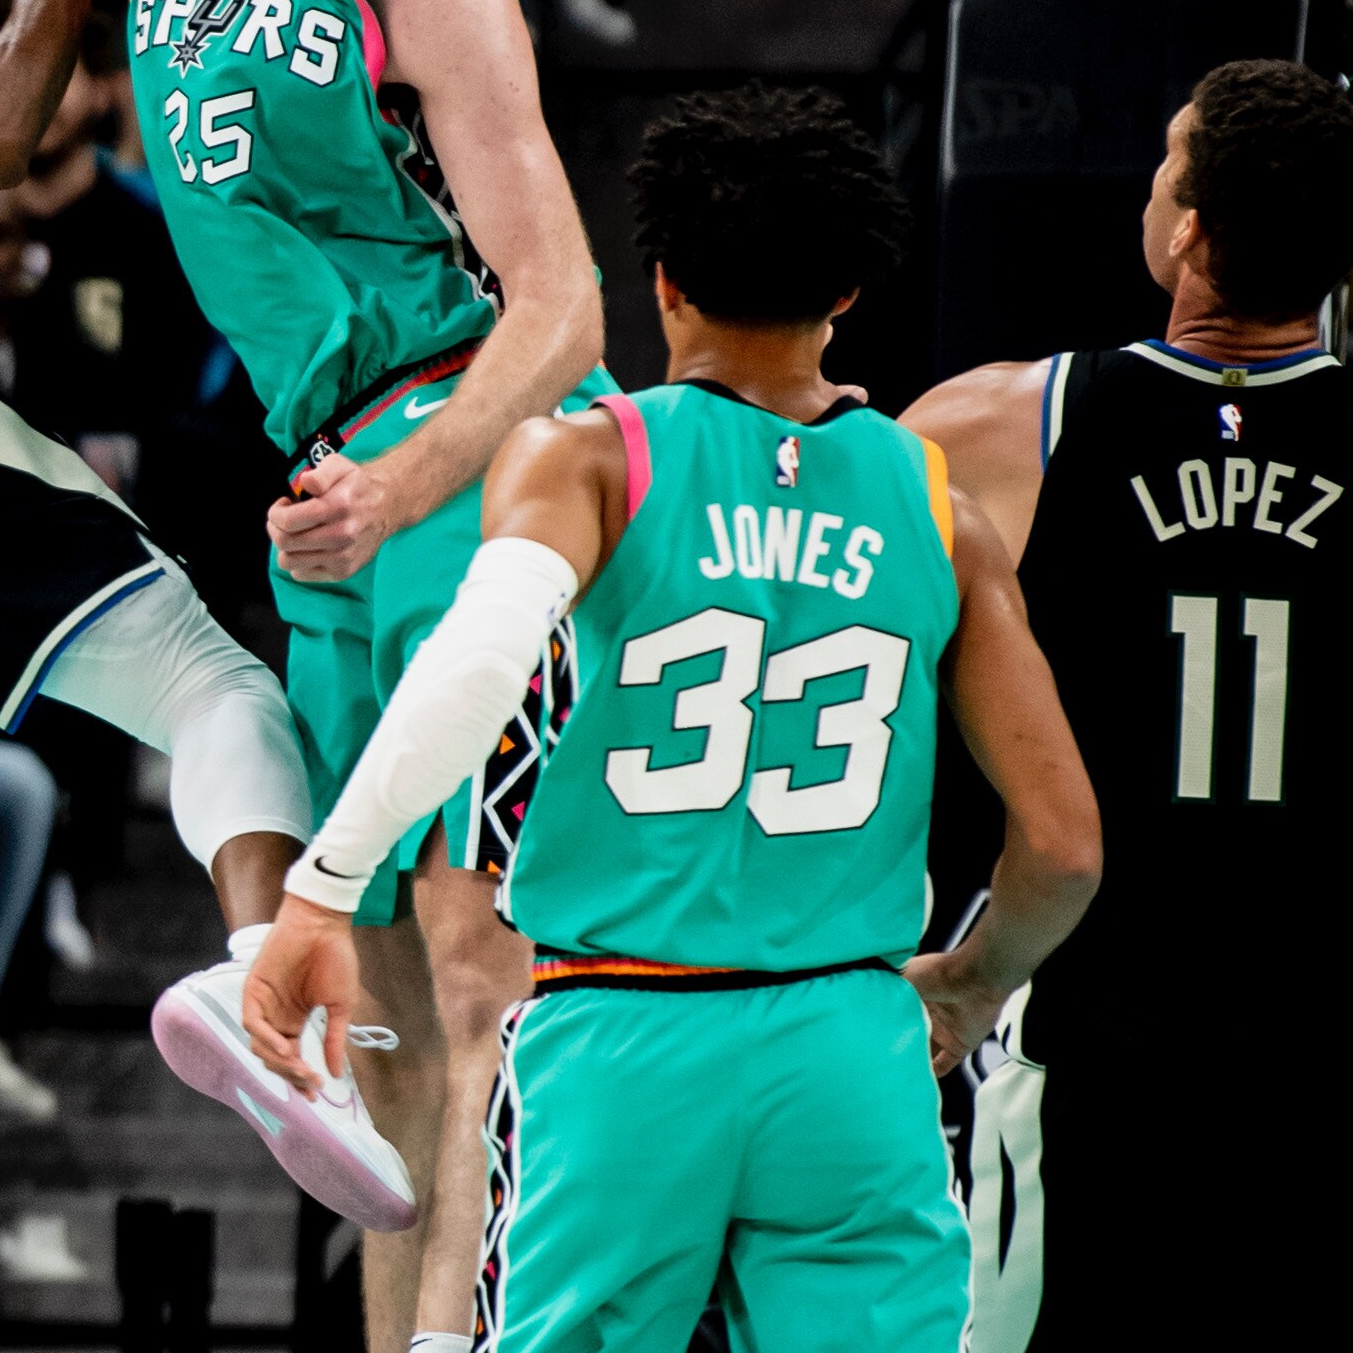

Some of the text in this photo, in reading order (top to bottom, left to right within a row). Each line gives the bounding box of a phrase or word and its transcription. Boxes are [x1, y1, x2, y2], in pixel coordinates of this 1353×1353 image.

[164, 87, 256, 186] 25
[698, 502, 885, 600] JONES
[1129, 456, 1345, 550] LOPEZ
[604, 606, 911, 836] 33
[1170, 594, 1291, 803] 11
